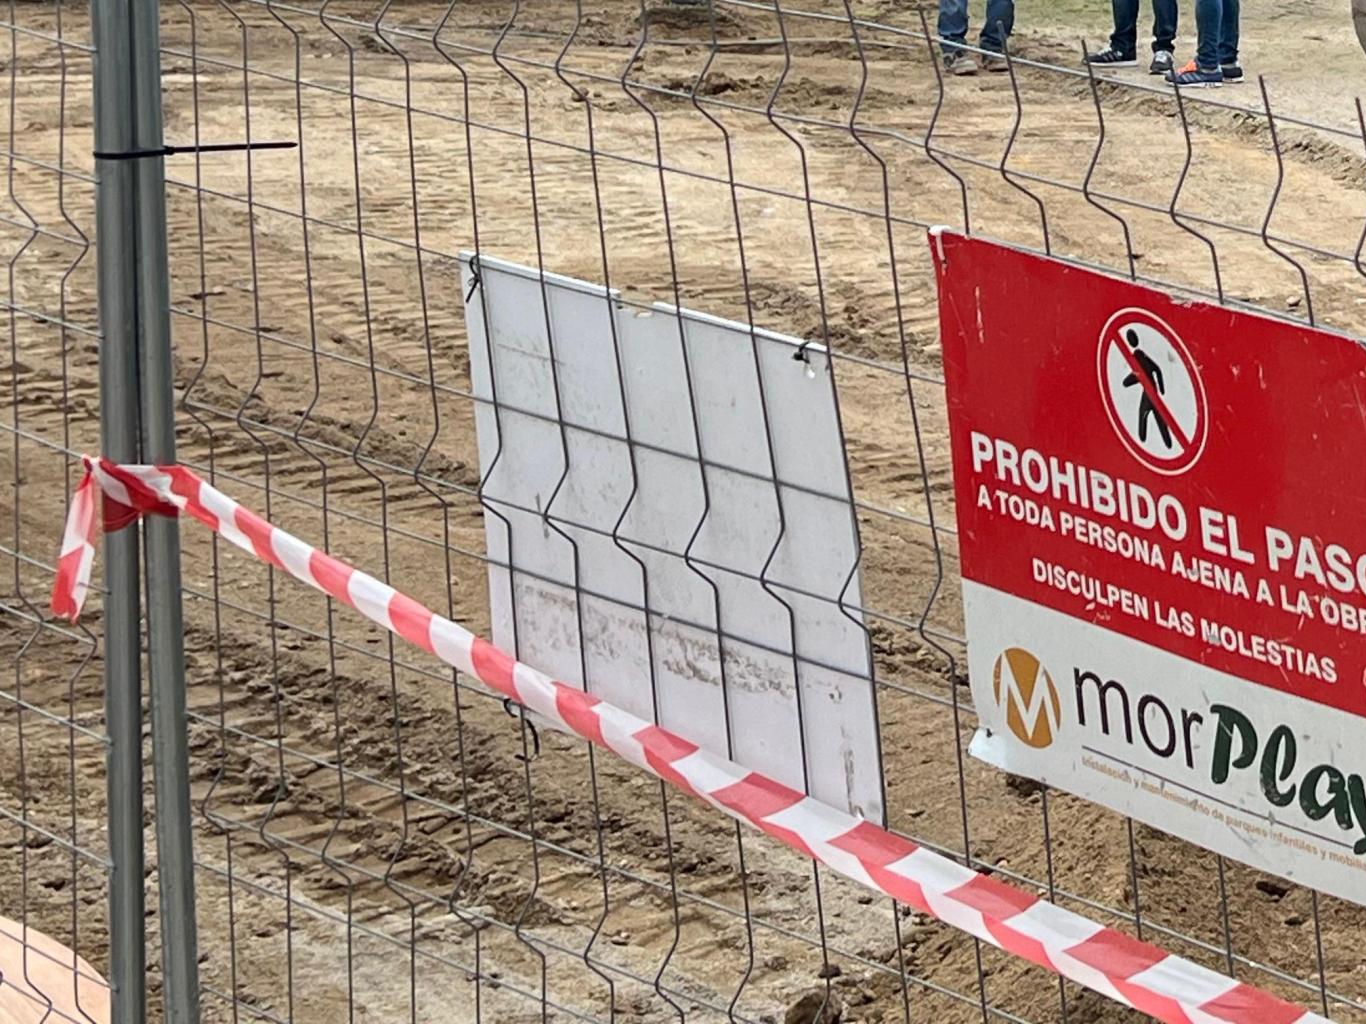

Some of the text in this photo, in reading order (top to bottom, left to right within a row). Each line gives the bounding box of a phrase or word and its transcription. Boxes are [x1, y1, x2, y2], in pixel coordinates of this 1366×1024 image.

[970, 430, 1188, 542] PROHIBIDO
[1199, 505, 1256, 565] EL
[976, 483, 993, 511] A
[994, 488, 1056, 533] TODA
[1059, 510, 1167, 572] PERSONA
[1170, 550, 1250, 600] AJENA
[1255, 578, 1275, 607] A
[1279, 583, 1315, 620] LA
[1031, 557, 1338, 684] DISCULPEN LAS MOLESTIAS
[1211, 808, 1225, 823] de
[1225, 815, 1268, 838] parques
[1320, 847, 1328, 861] y
